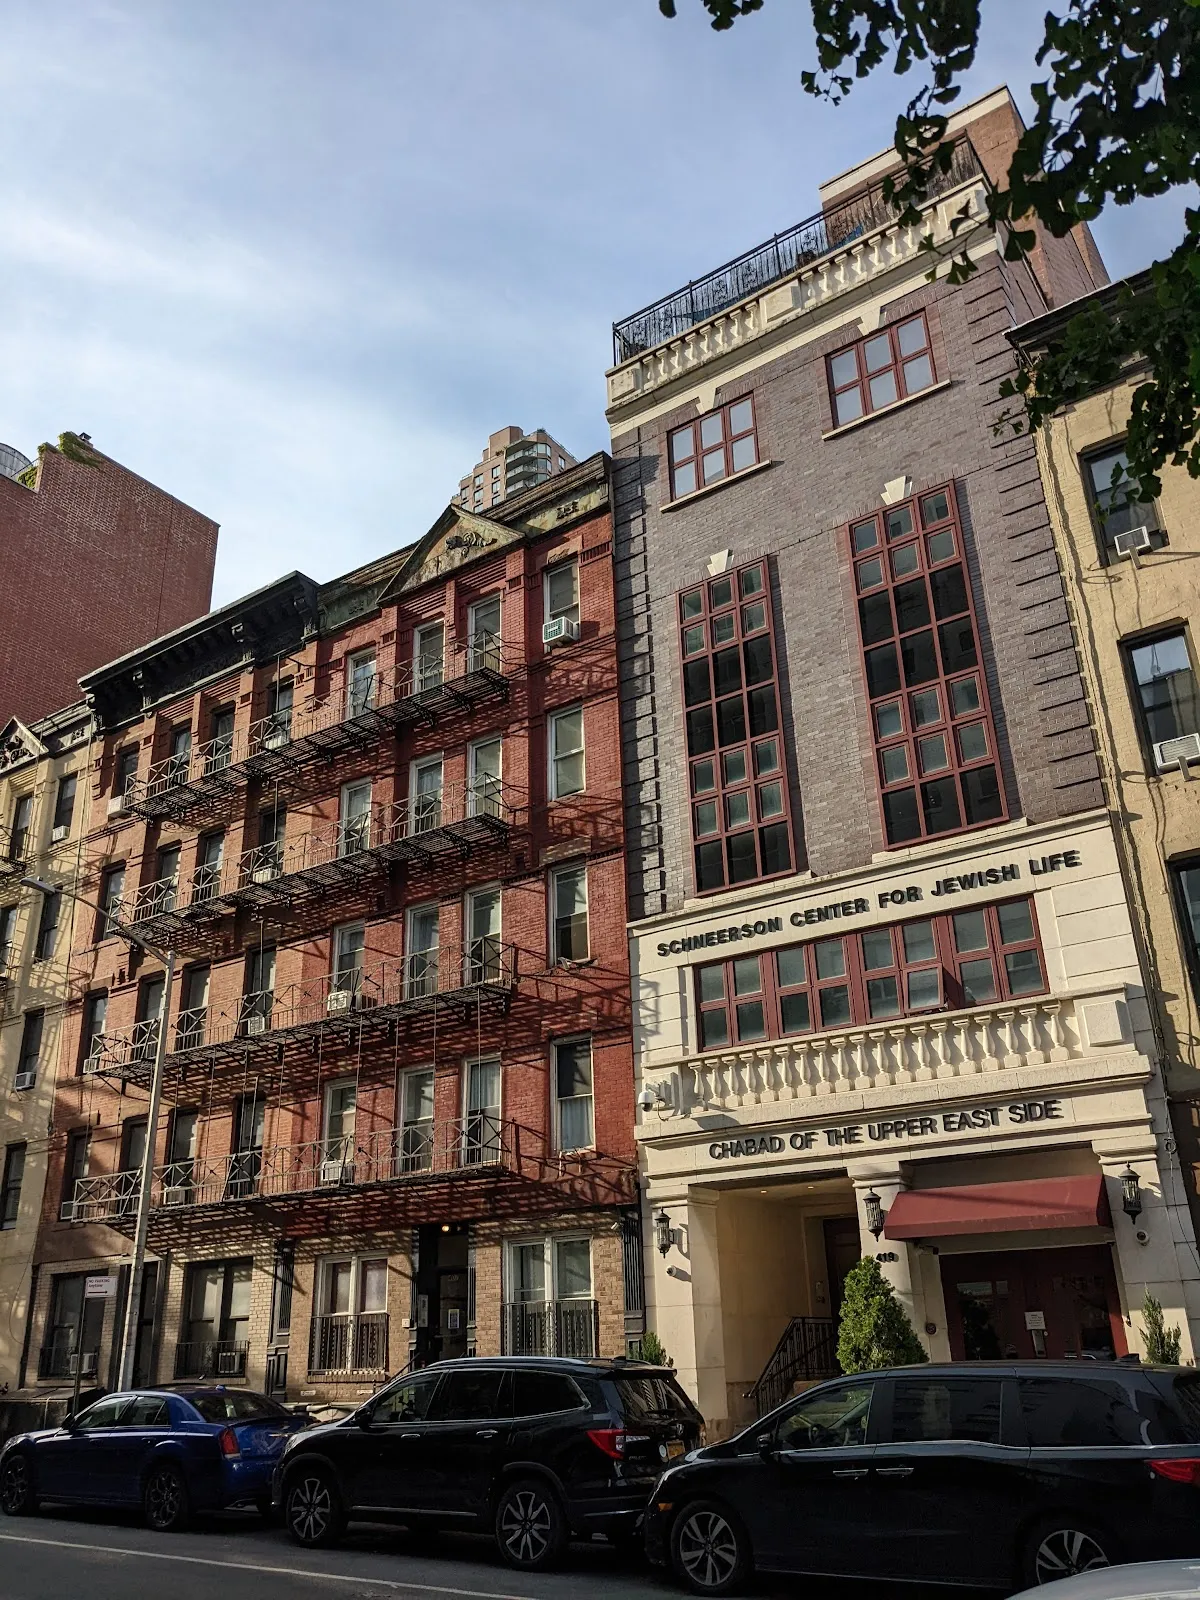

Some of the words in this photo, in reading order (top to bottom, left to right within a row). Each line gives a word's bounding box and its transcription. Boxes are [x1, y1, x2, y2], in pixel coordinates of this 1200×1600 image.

[657, 917, 782, 957] SCHNEERSON
[790, 898, 868, 927] CENTER
[878, 886, 923, 908] FOR
[931, 864, 1020, 896] JEWISH
[1029, 850, 1081, 875] LIFE
[709, 1136, 785, 1160] CHABAD
[790, 1131, 819, 1150] OF
[823, 1126, 864, 1146] THE
[868, 1117, 937, 1141] UPPER
[943, 1108, 1002, 1132] EAST
[1009, 1100, 1064, 1123] SIDE
[876, 1252, 896, 1261] 419
